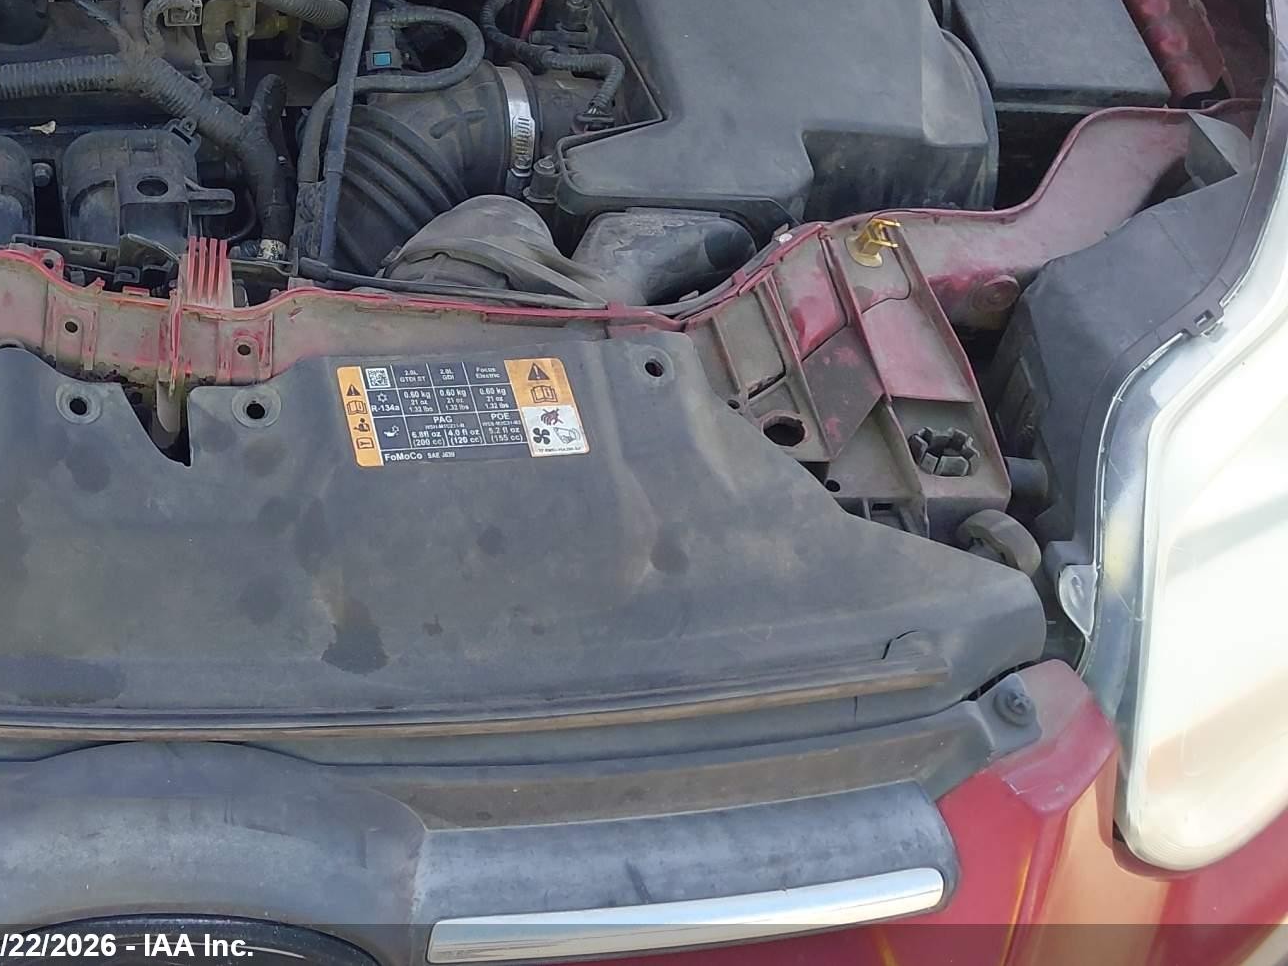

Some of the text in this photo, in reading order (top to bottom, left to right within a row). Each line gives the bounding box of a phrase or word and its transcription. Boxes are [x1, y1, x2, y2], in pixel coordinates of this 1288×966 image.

[403, 390, 431, 400] 0.60 kg
[456, 388, 467, 397] kg
[496, 387, 507, 396] kg
[371, 404, 400, 412] R-134a
[461, 428, 468, 436] fl
[502, 426, 508, 434] fl
[413, 437, 446, 447] (200 cc)
[451, 436, 483, 446] (120 cc)
[510, 434, 523, 442] cc)
[384, 451, 423, 461] FoMoCo
